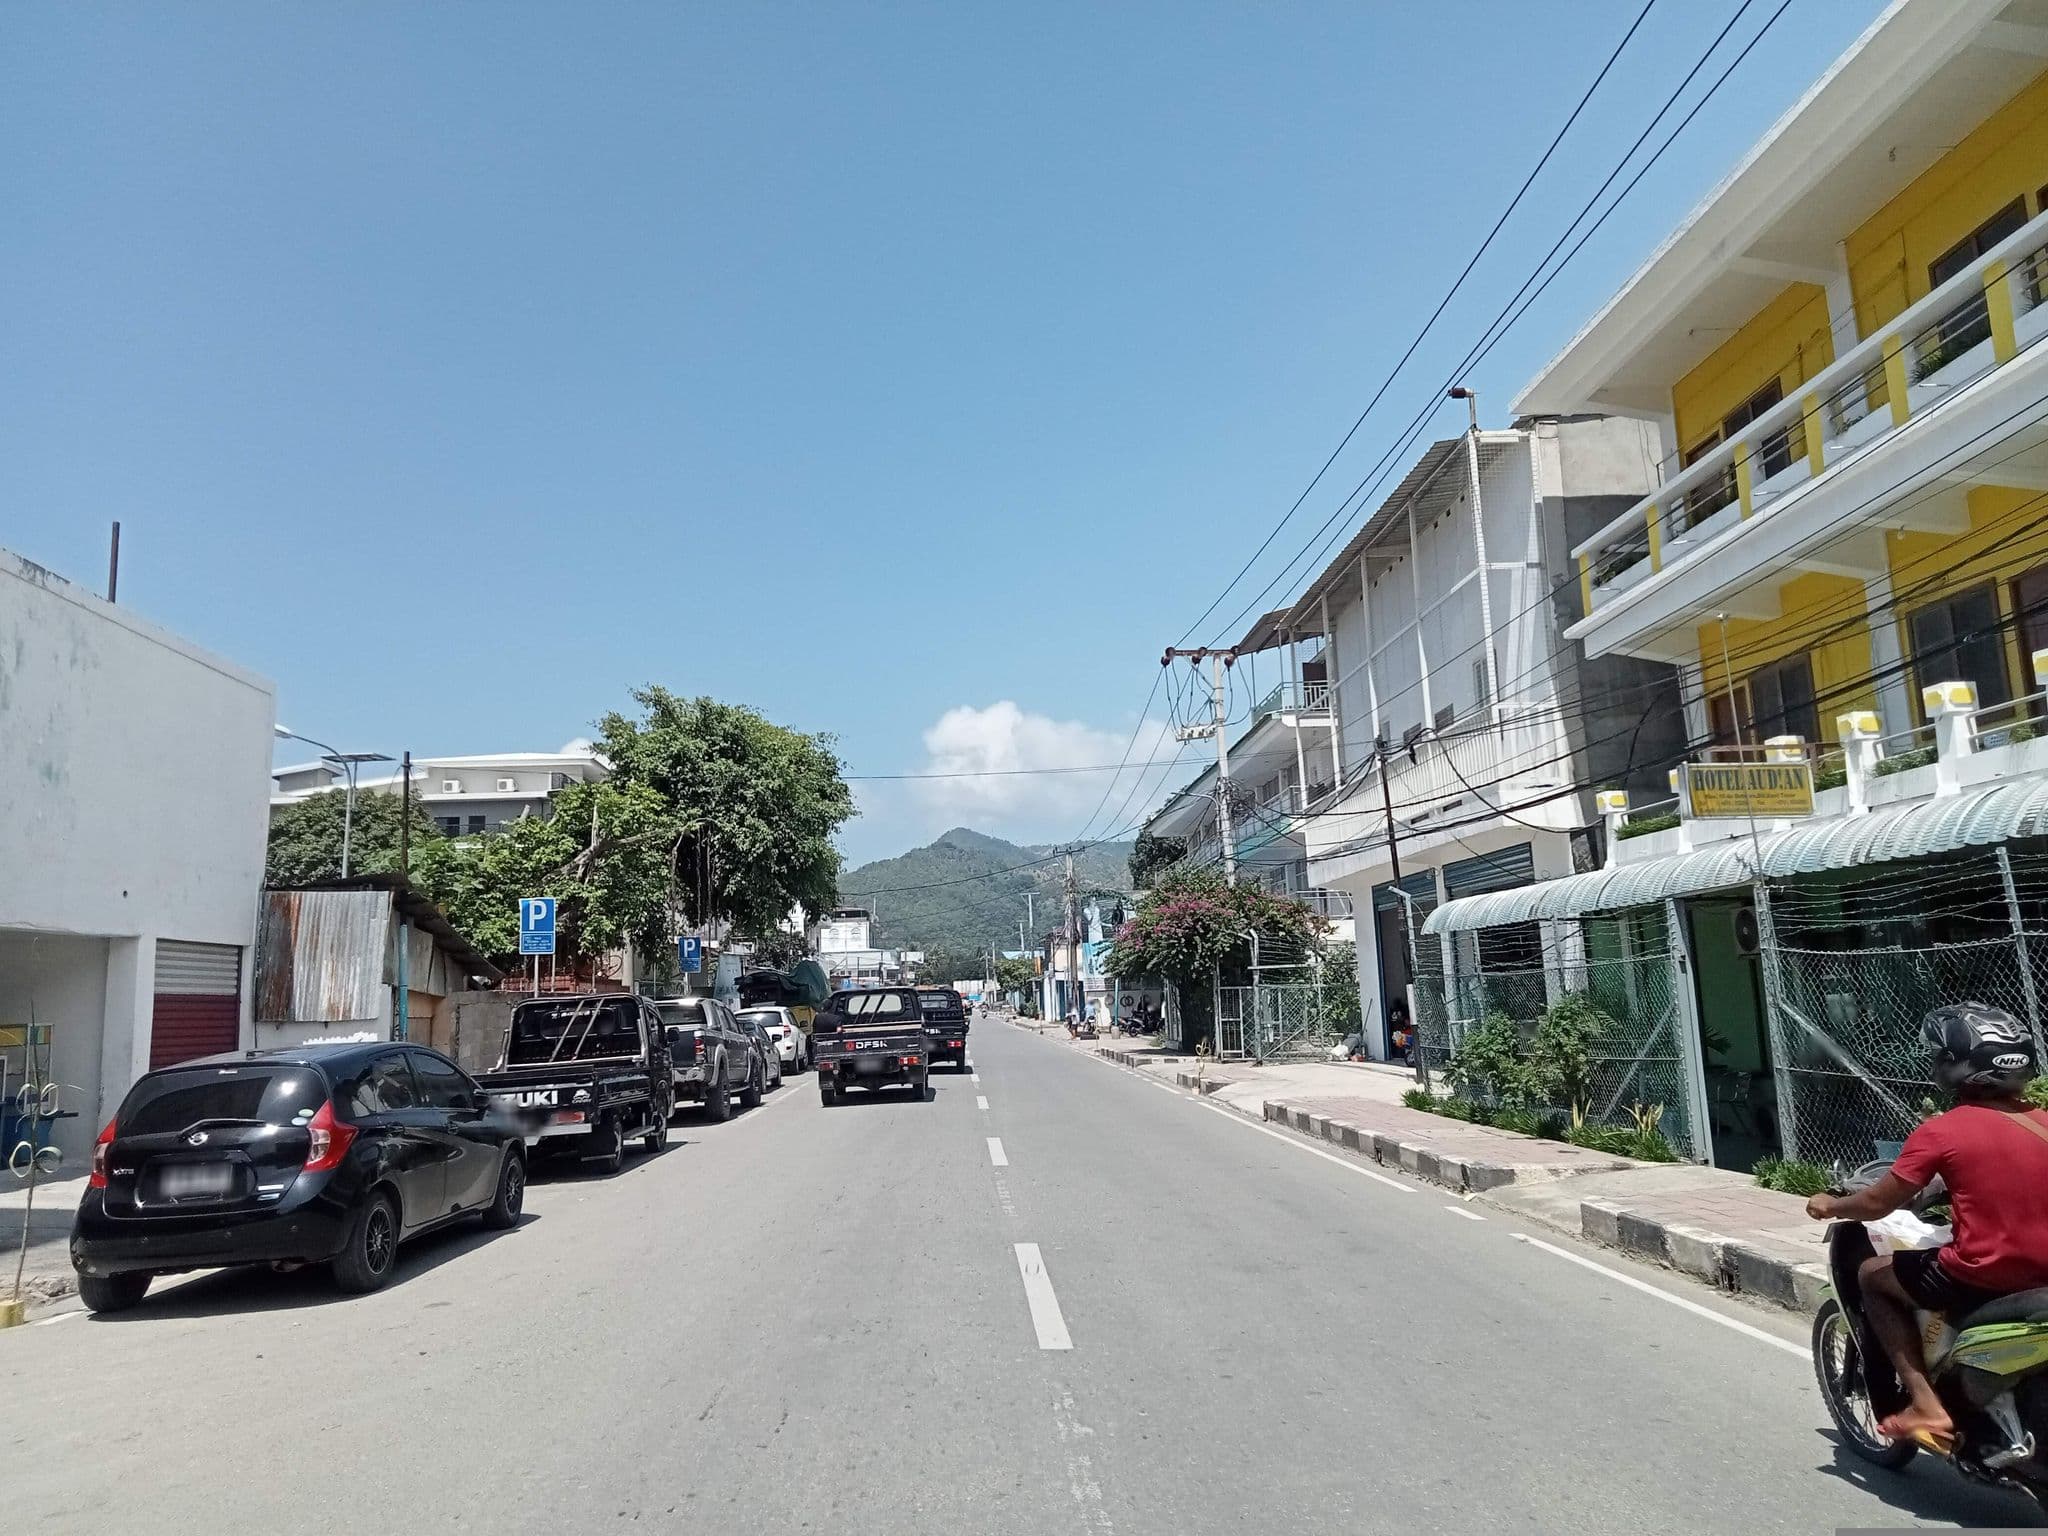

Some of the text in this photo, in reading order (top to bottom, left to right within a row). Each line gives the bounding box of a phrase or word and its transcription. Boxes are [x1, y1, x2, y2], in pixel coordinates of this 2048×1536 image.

[1694, 769, 1743, 791] HOTEL
[529, 900, 547, 931] P
[683, 938, 696, 958] P
[855, 1040, 888, 1050] DFSK
